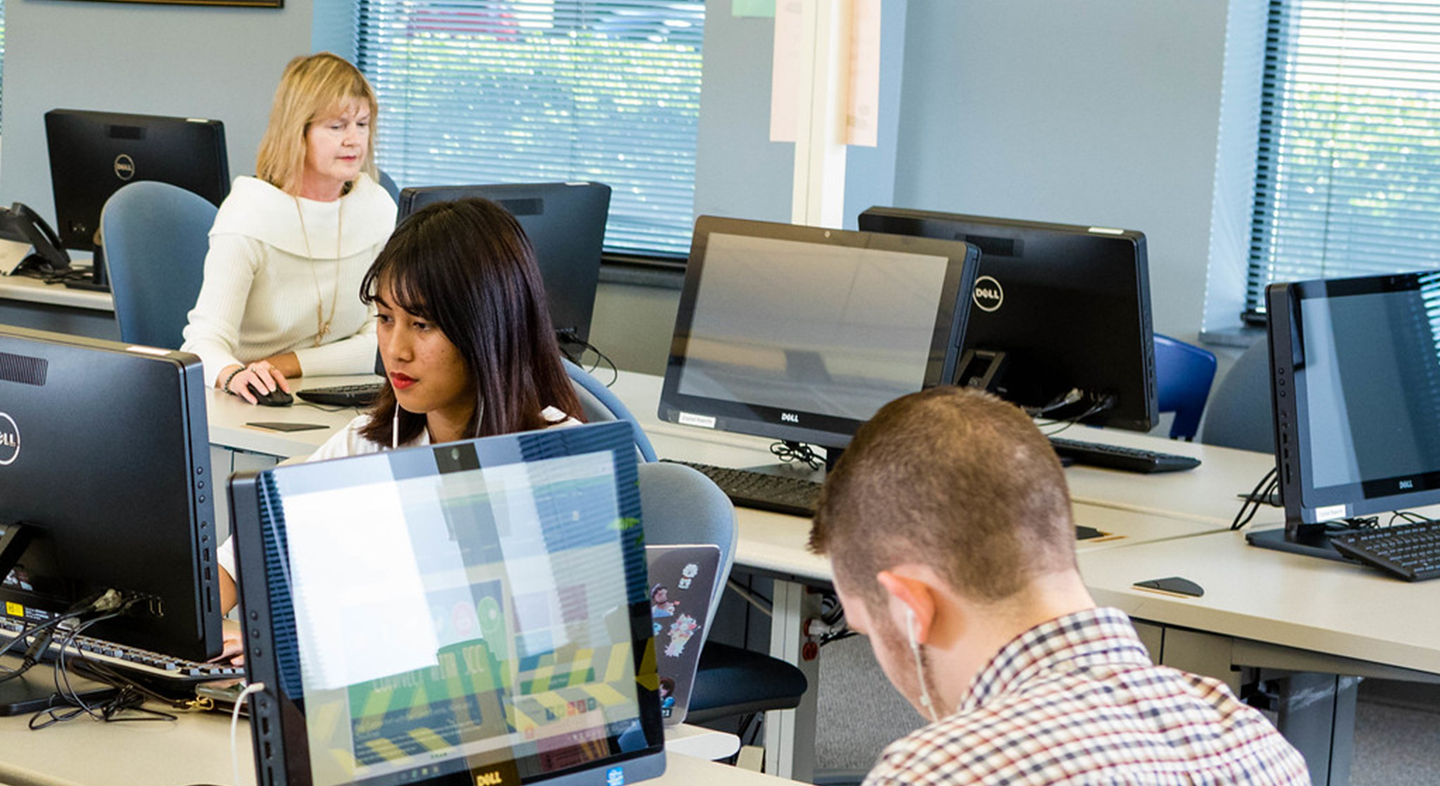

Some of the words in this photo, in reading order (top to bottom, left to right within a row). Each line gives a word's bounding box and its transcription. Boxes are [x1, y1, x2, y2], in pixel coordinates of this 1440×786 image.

[975, 288, 1000, 299] DELL
[781, 412, 799, 422] DELL
[477, 771, 502, 786] DELL
